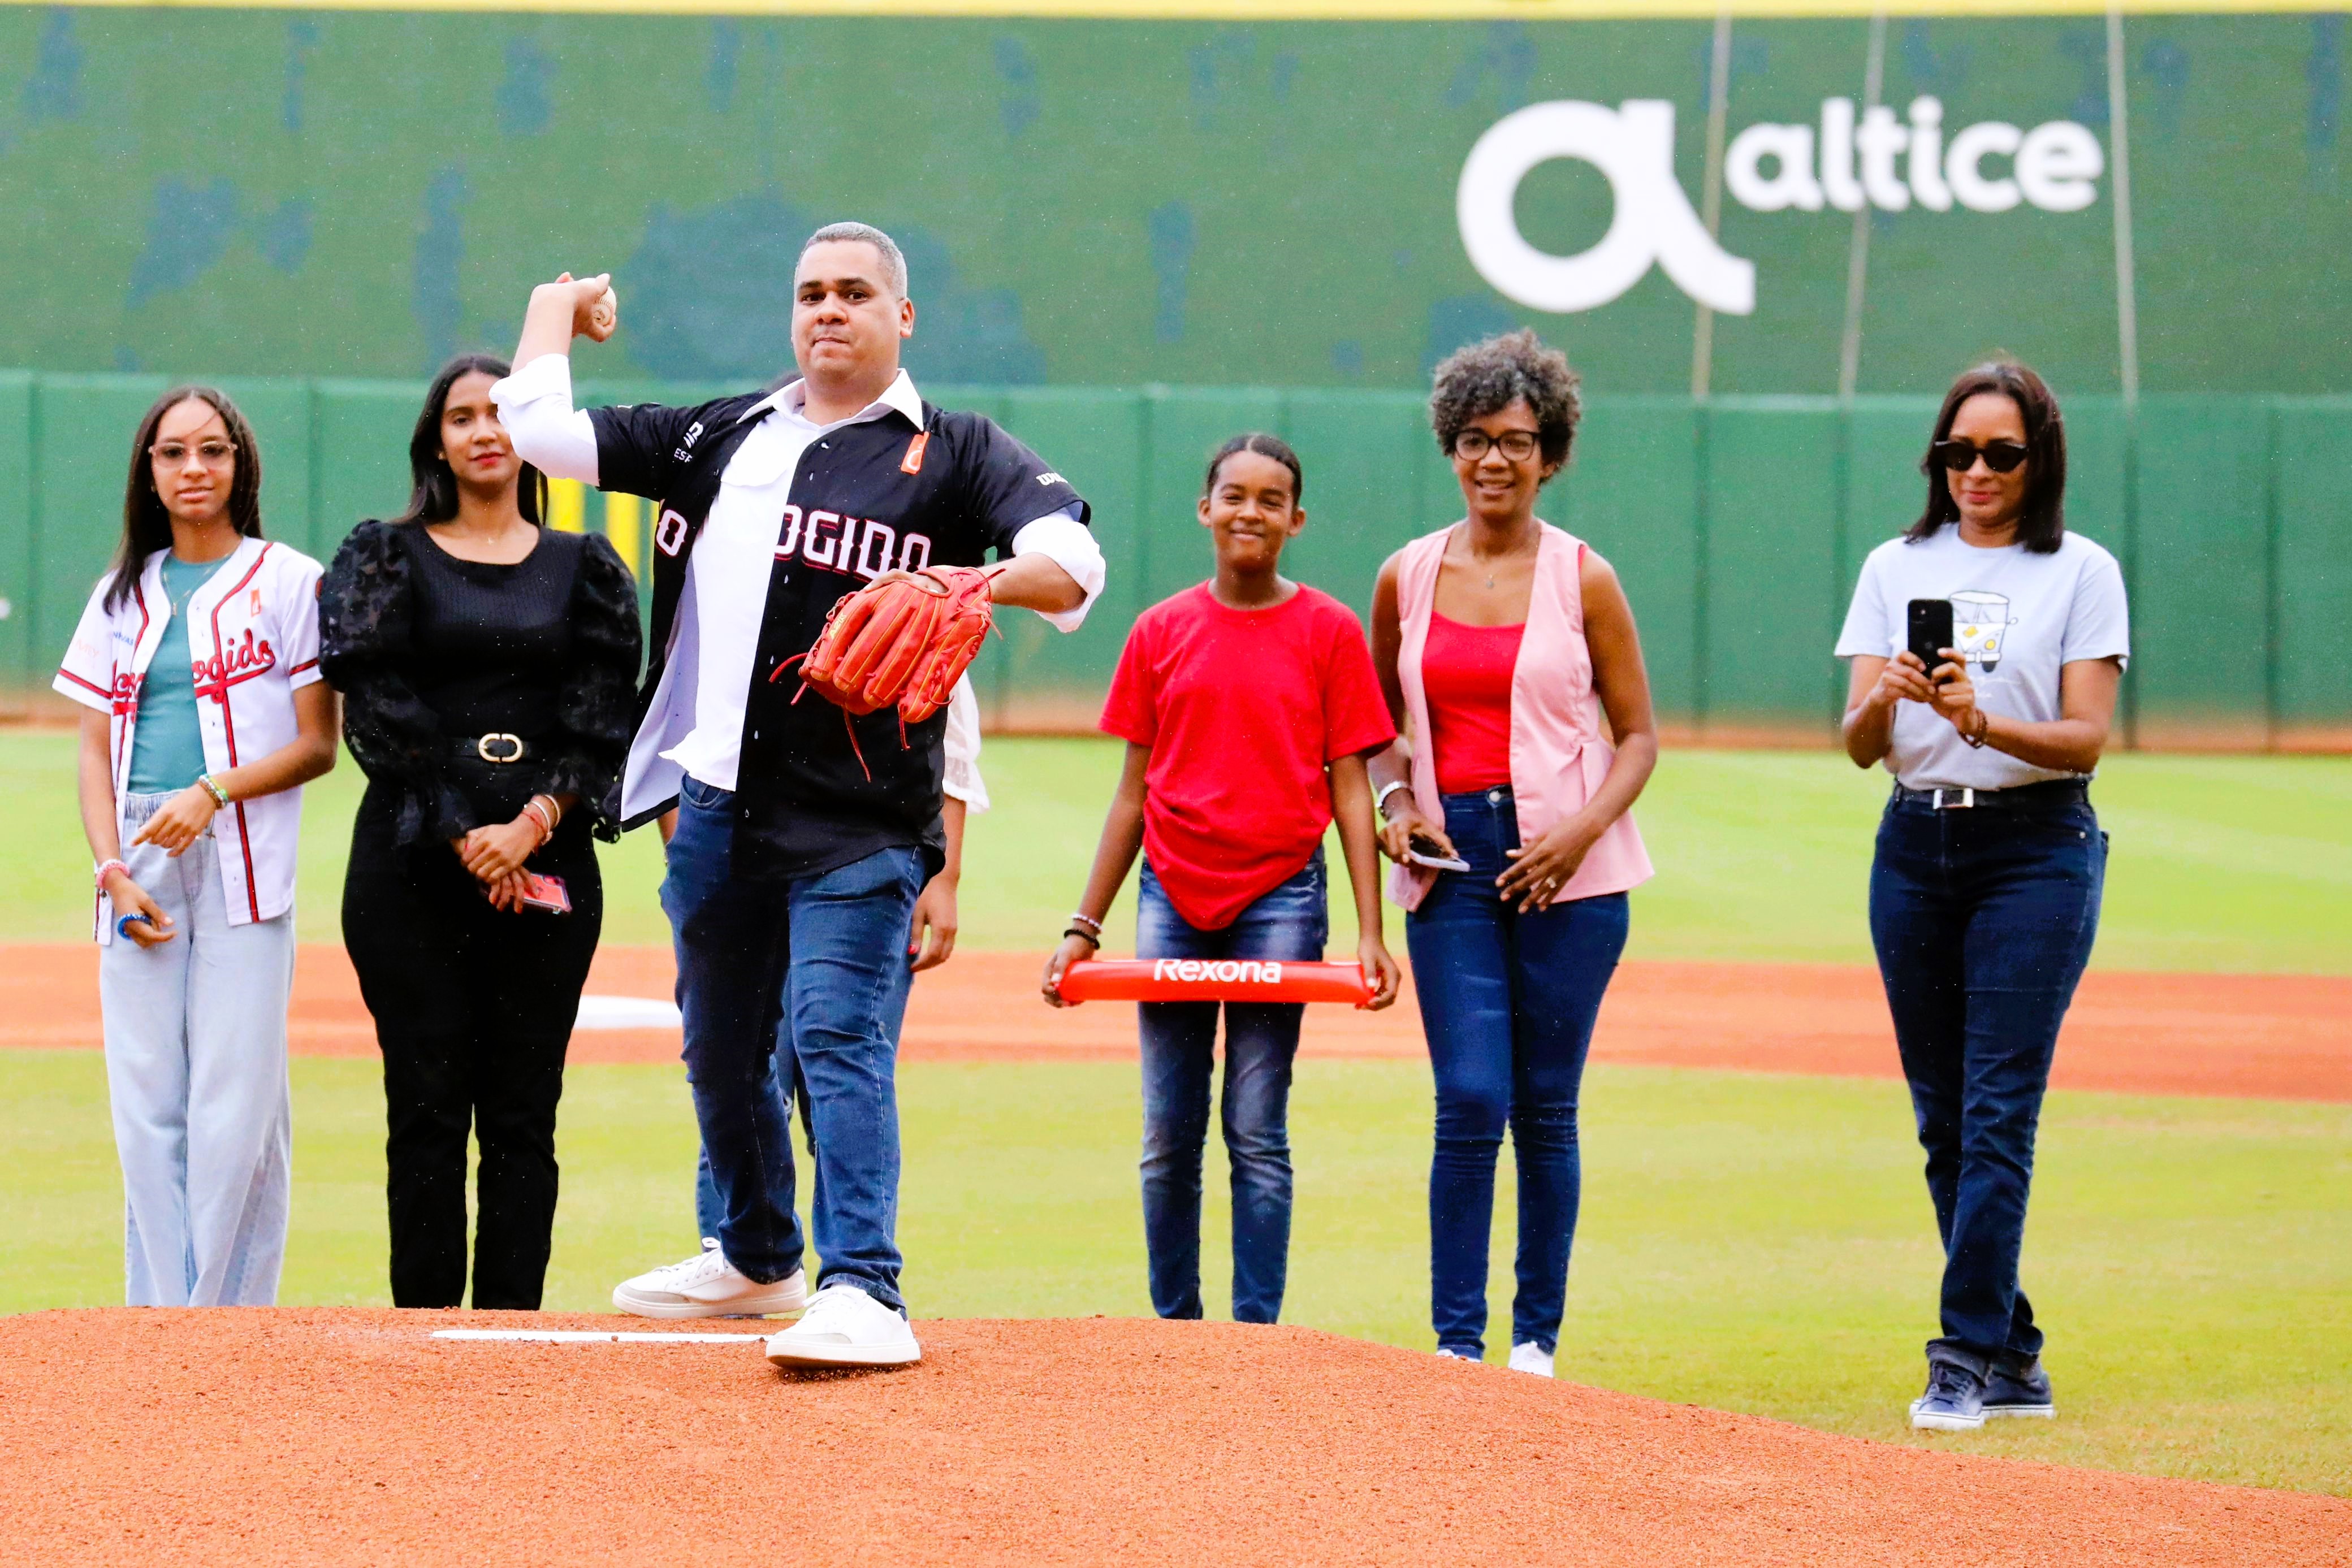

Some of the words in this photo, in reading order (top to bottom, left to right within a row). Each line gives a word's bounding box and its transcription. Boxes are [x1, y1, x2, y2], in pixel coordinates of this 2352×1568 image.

[1726, 95, 2104, 212] altice
[829, 612, 847, 640] A2K
[1154, 958, 1282, 984] Rexona
